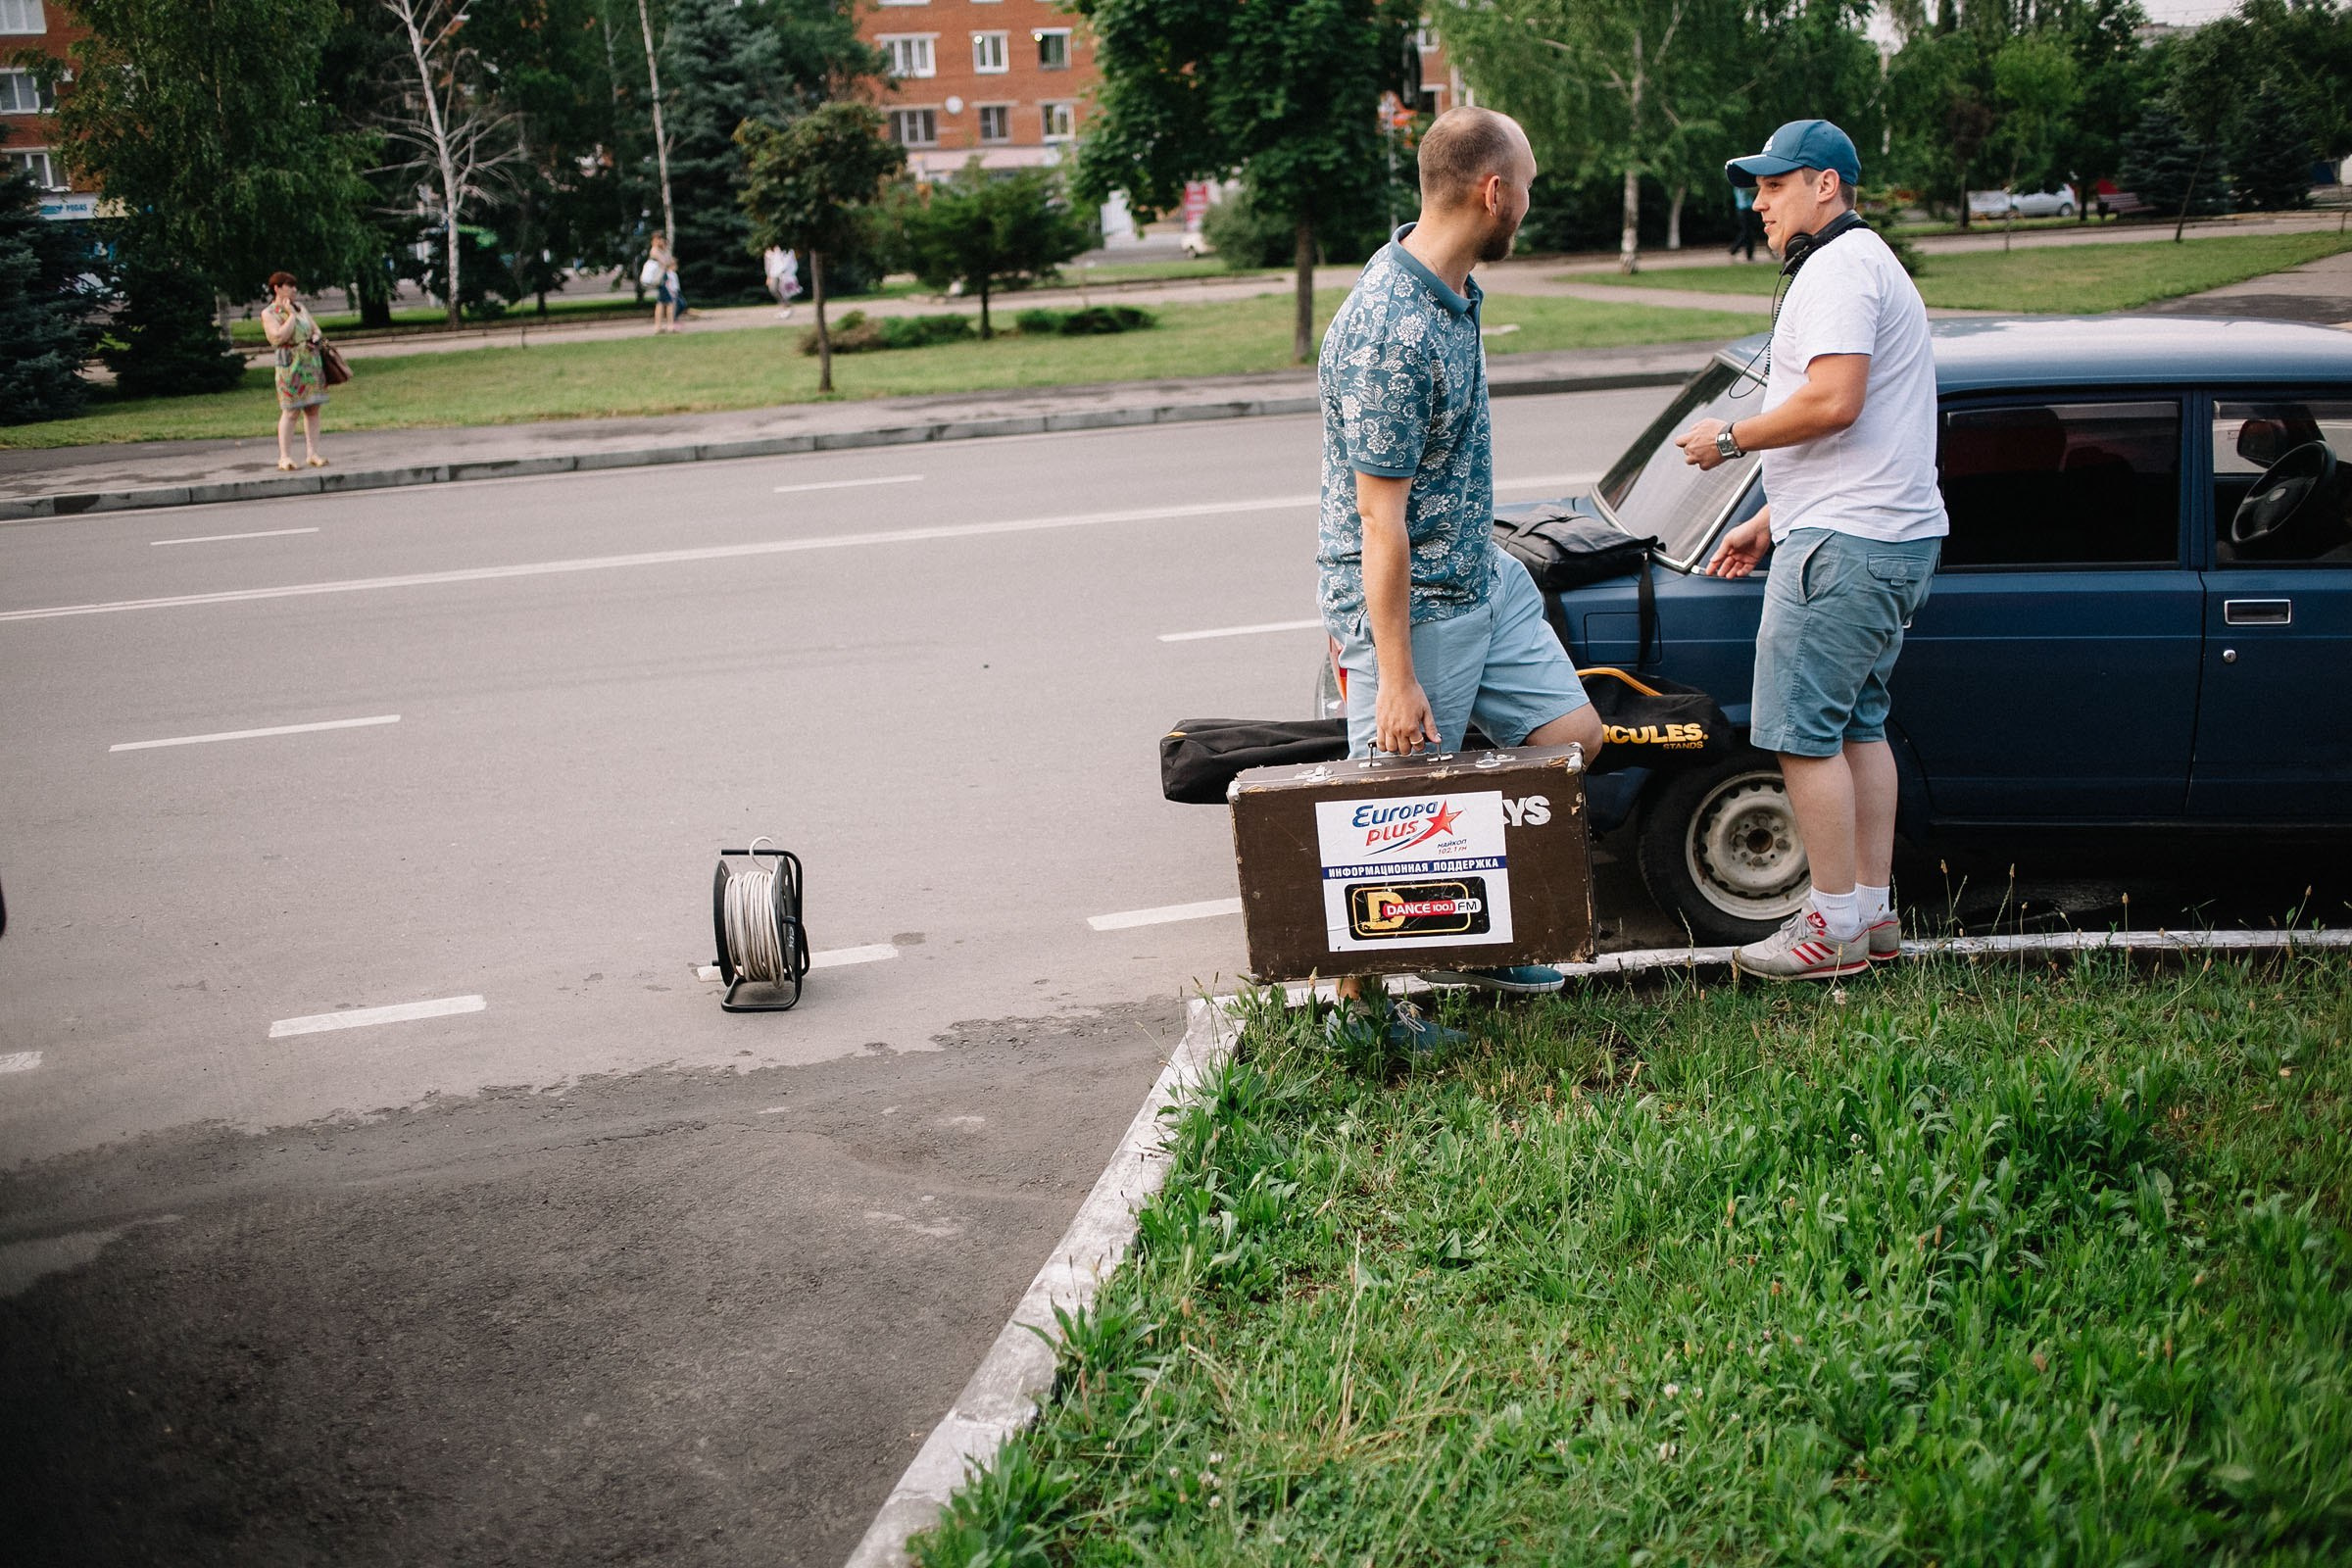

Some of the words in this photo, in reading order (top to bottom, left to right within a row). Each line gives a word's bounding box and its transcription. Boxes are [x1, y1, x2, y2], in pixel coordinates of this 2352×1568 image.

[1663, 741, 1704, 750] STANDS
[1352, 802, 1438, 827] Europa
[1503, 795, 1551, 826] YS
[1328, 862, 1429, 878] ИНФОРМАЦИОННАЯ
[1433, 858, 1499, 873] ПОДДЕРЖКА
[1387, 903, 1431, 915] DANCE
[1433, 904, 1454, 912] 100.1
[1457, 901, 1477, 911] FM
